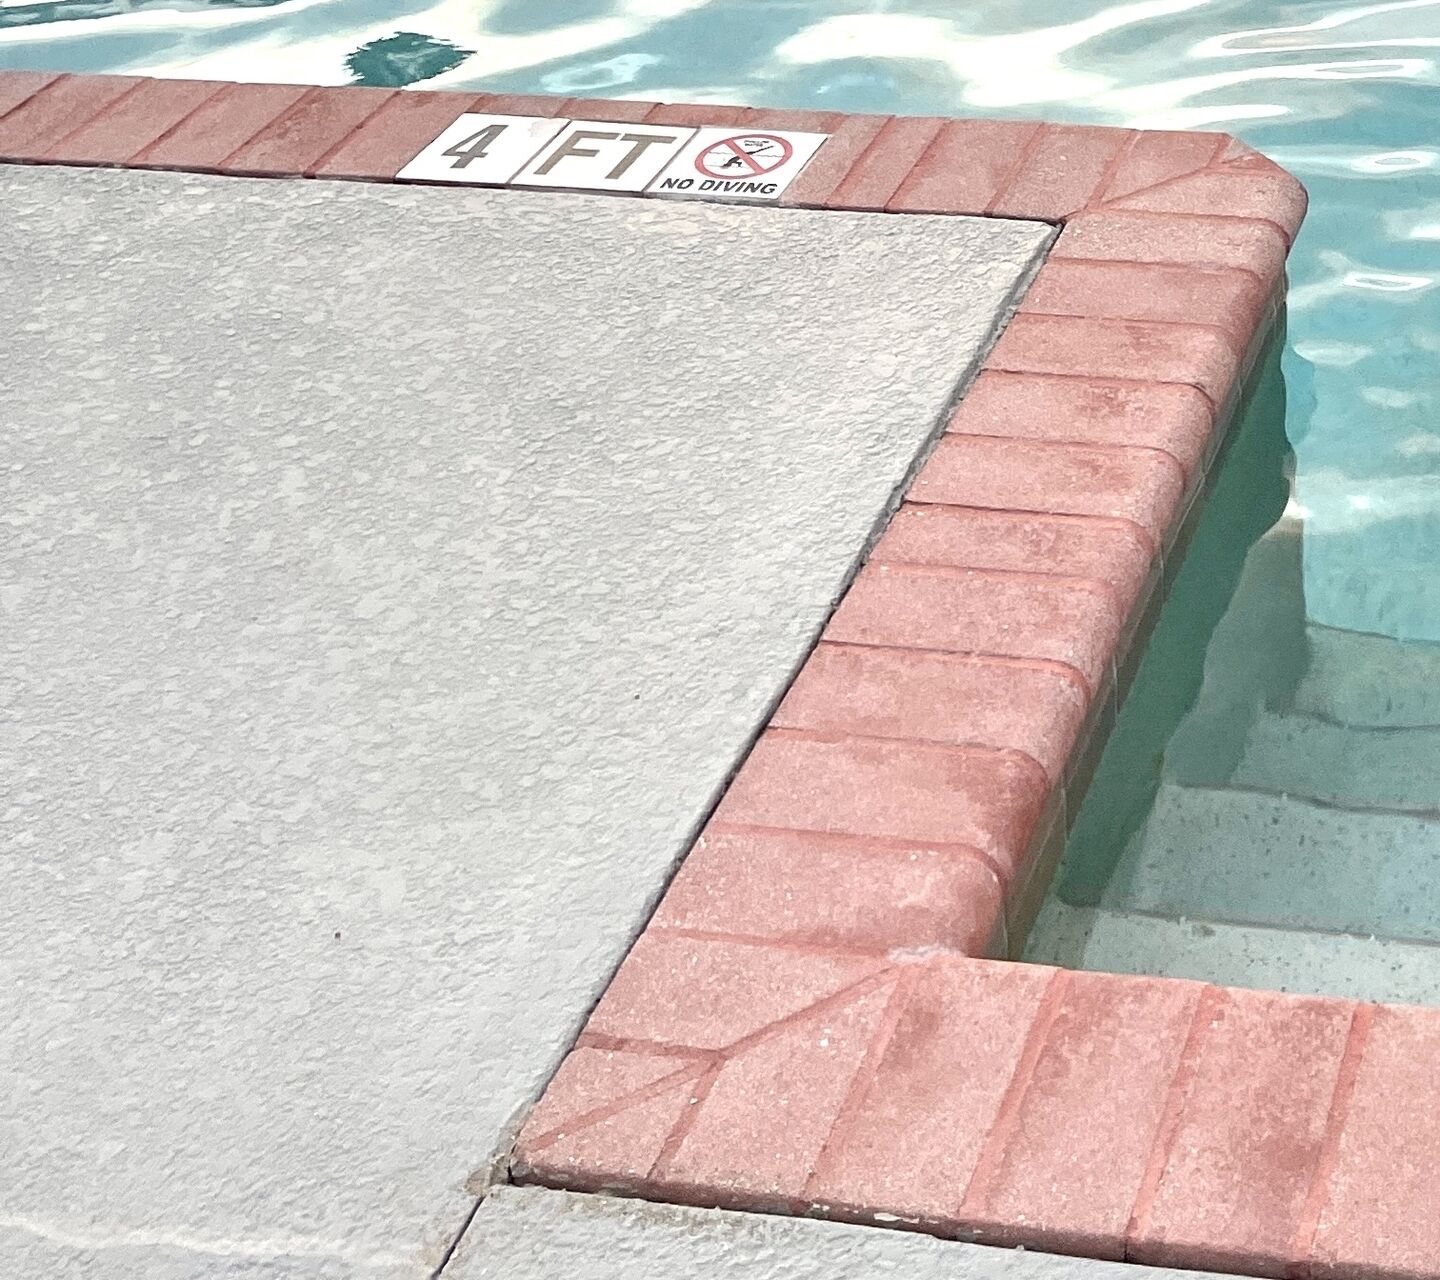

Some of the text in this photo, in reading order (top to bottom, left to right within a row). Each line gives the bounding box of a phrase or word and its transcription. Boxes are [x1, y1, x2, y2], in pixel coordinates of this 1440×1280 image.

[441, 124, 678, 180] 4 FT
[659, 177, 778, 194] NO DIVING
